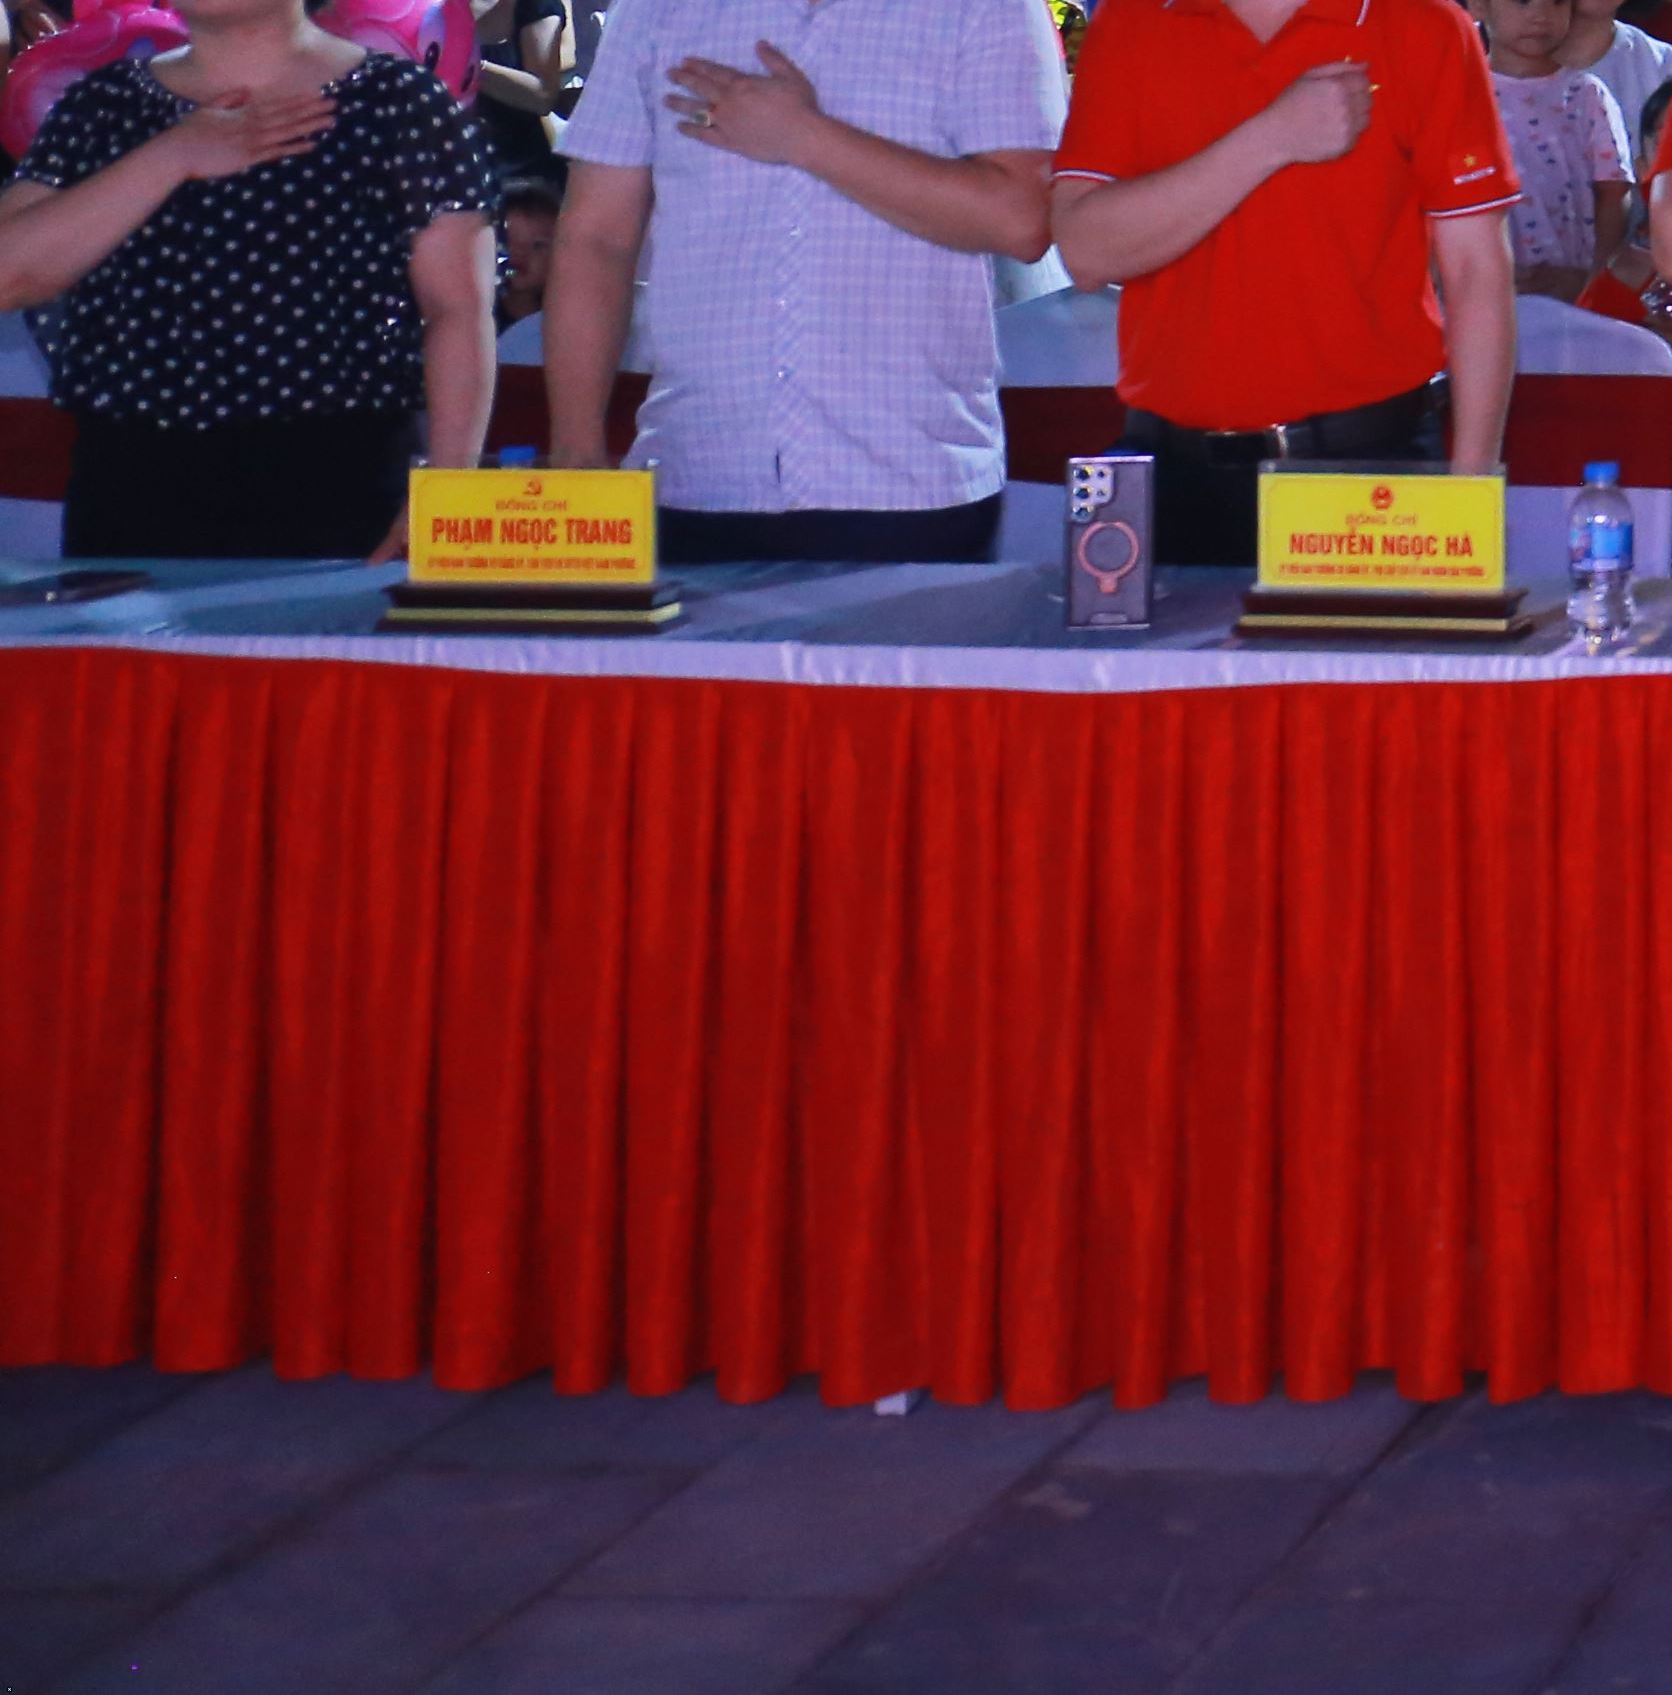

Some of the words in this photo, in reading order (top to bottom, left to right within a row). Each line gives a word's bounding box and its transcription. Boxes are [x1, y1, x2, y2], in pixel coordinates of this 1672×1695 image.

[431, 517, 493, 550] PHẠM
[501, 517, 558, 550] NGỌC
[565, 518, 632, 544] TRANG
[1381, 535, 1437, 561] NGỌC
